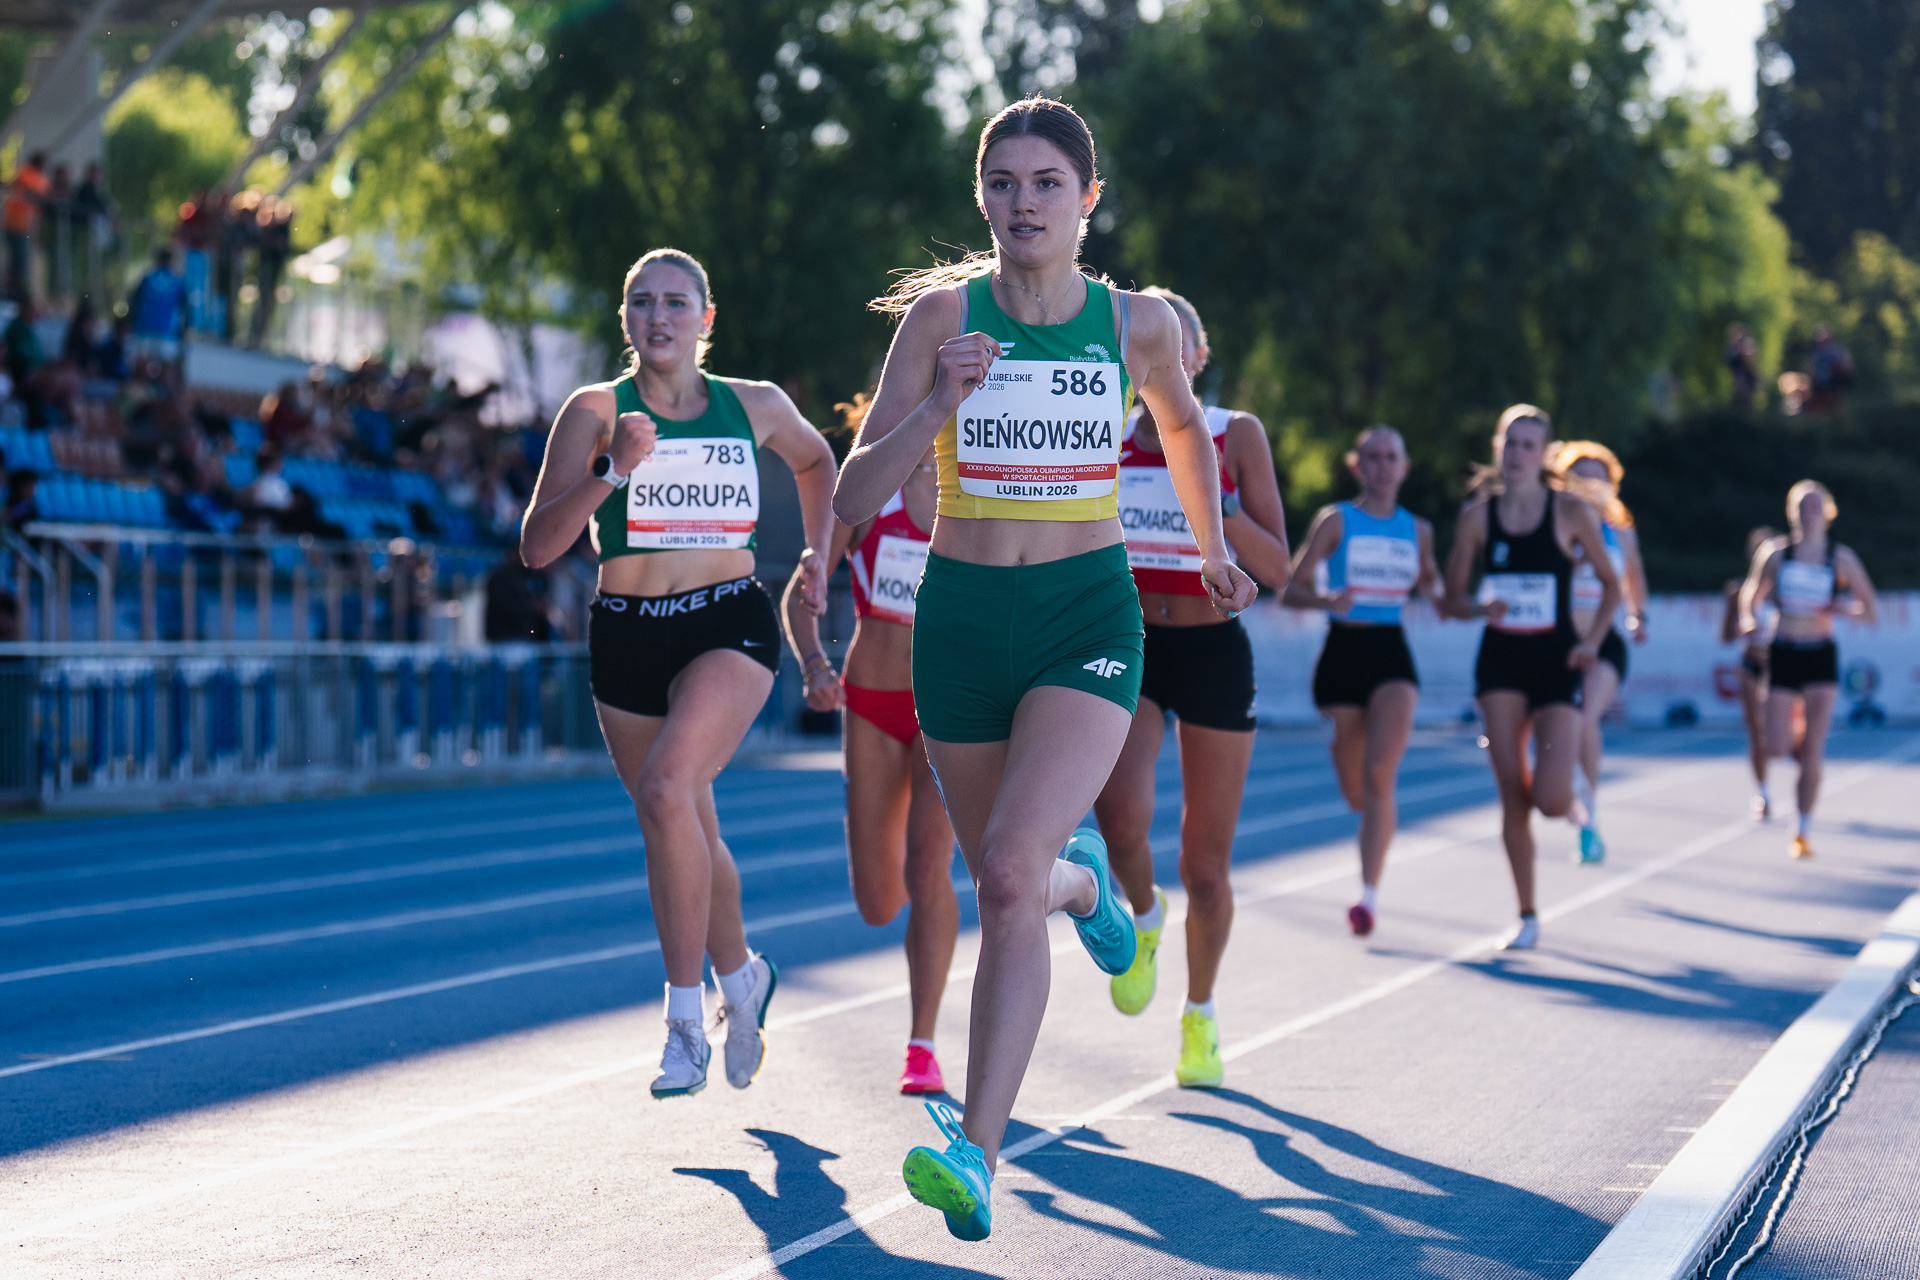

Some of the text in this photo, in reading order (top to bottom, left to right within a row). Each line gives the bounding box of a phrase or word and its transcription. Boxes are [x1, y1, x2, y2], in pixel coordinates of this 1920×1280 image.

[988, 373, 1033, 382] LUBELSKIE
[988, 383, 1005, 391] 2026
[1050, 369, 1107, 396] 586
[963, 412, 1113, 450] SIEŃKOWSKA
[702, 444, 745, 465] 783
[984, 464, 1038, 474] OGÓLNOPOLSKA
[1075, 465, 1109, 473] MŁODZIEŻY
[634, 483, 752, 508] SKORUPA
[996, 484, 1078, 497] LUBLIN 2026
[1118, 507, 1191, 533] CZMARCZ
[659, 535, 728, 545] LUBLIN 2026
[638, 589, 709, 617] NIKE
